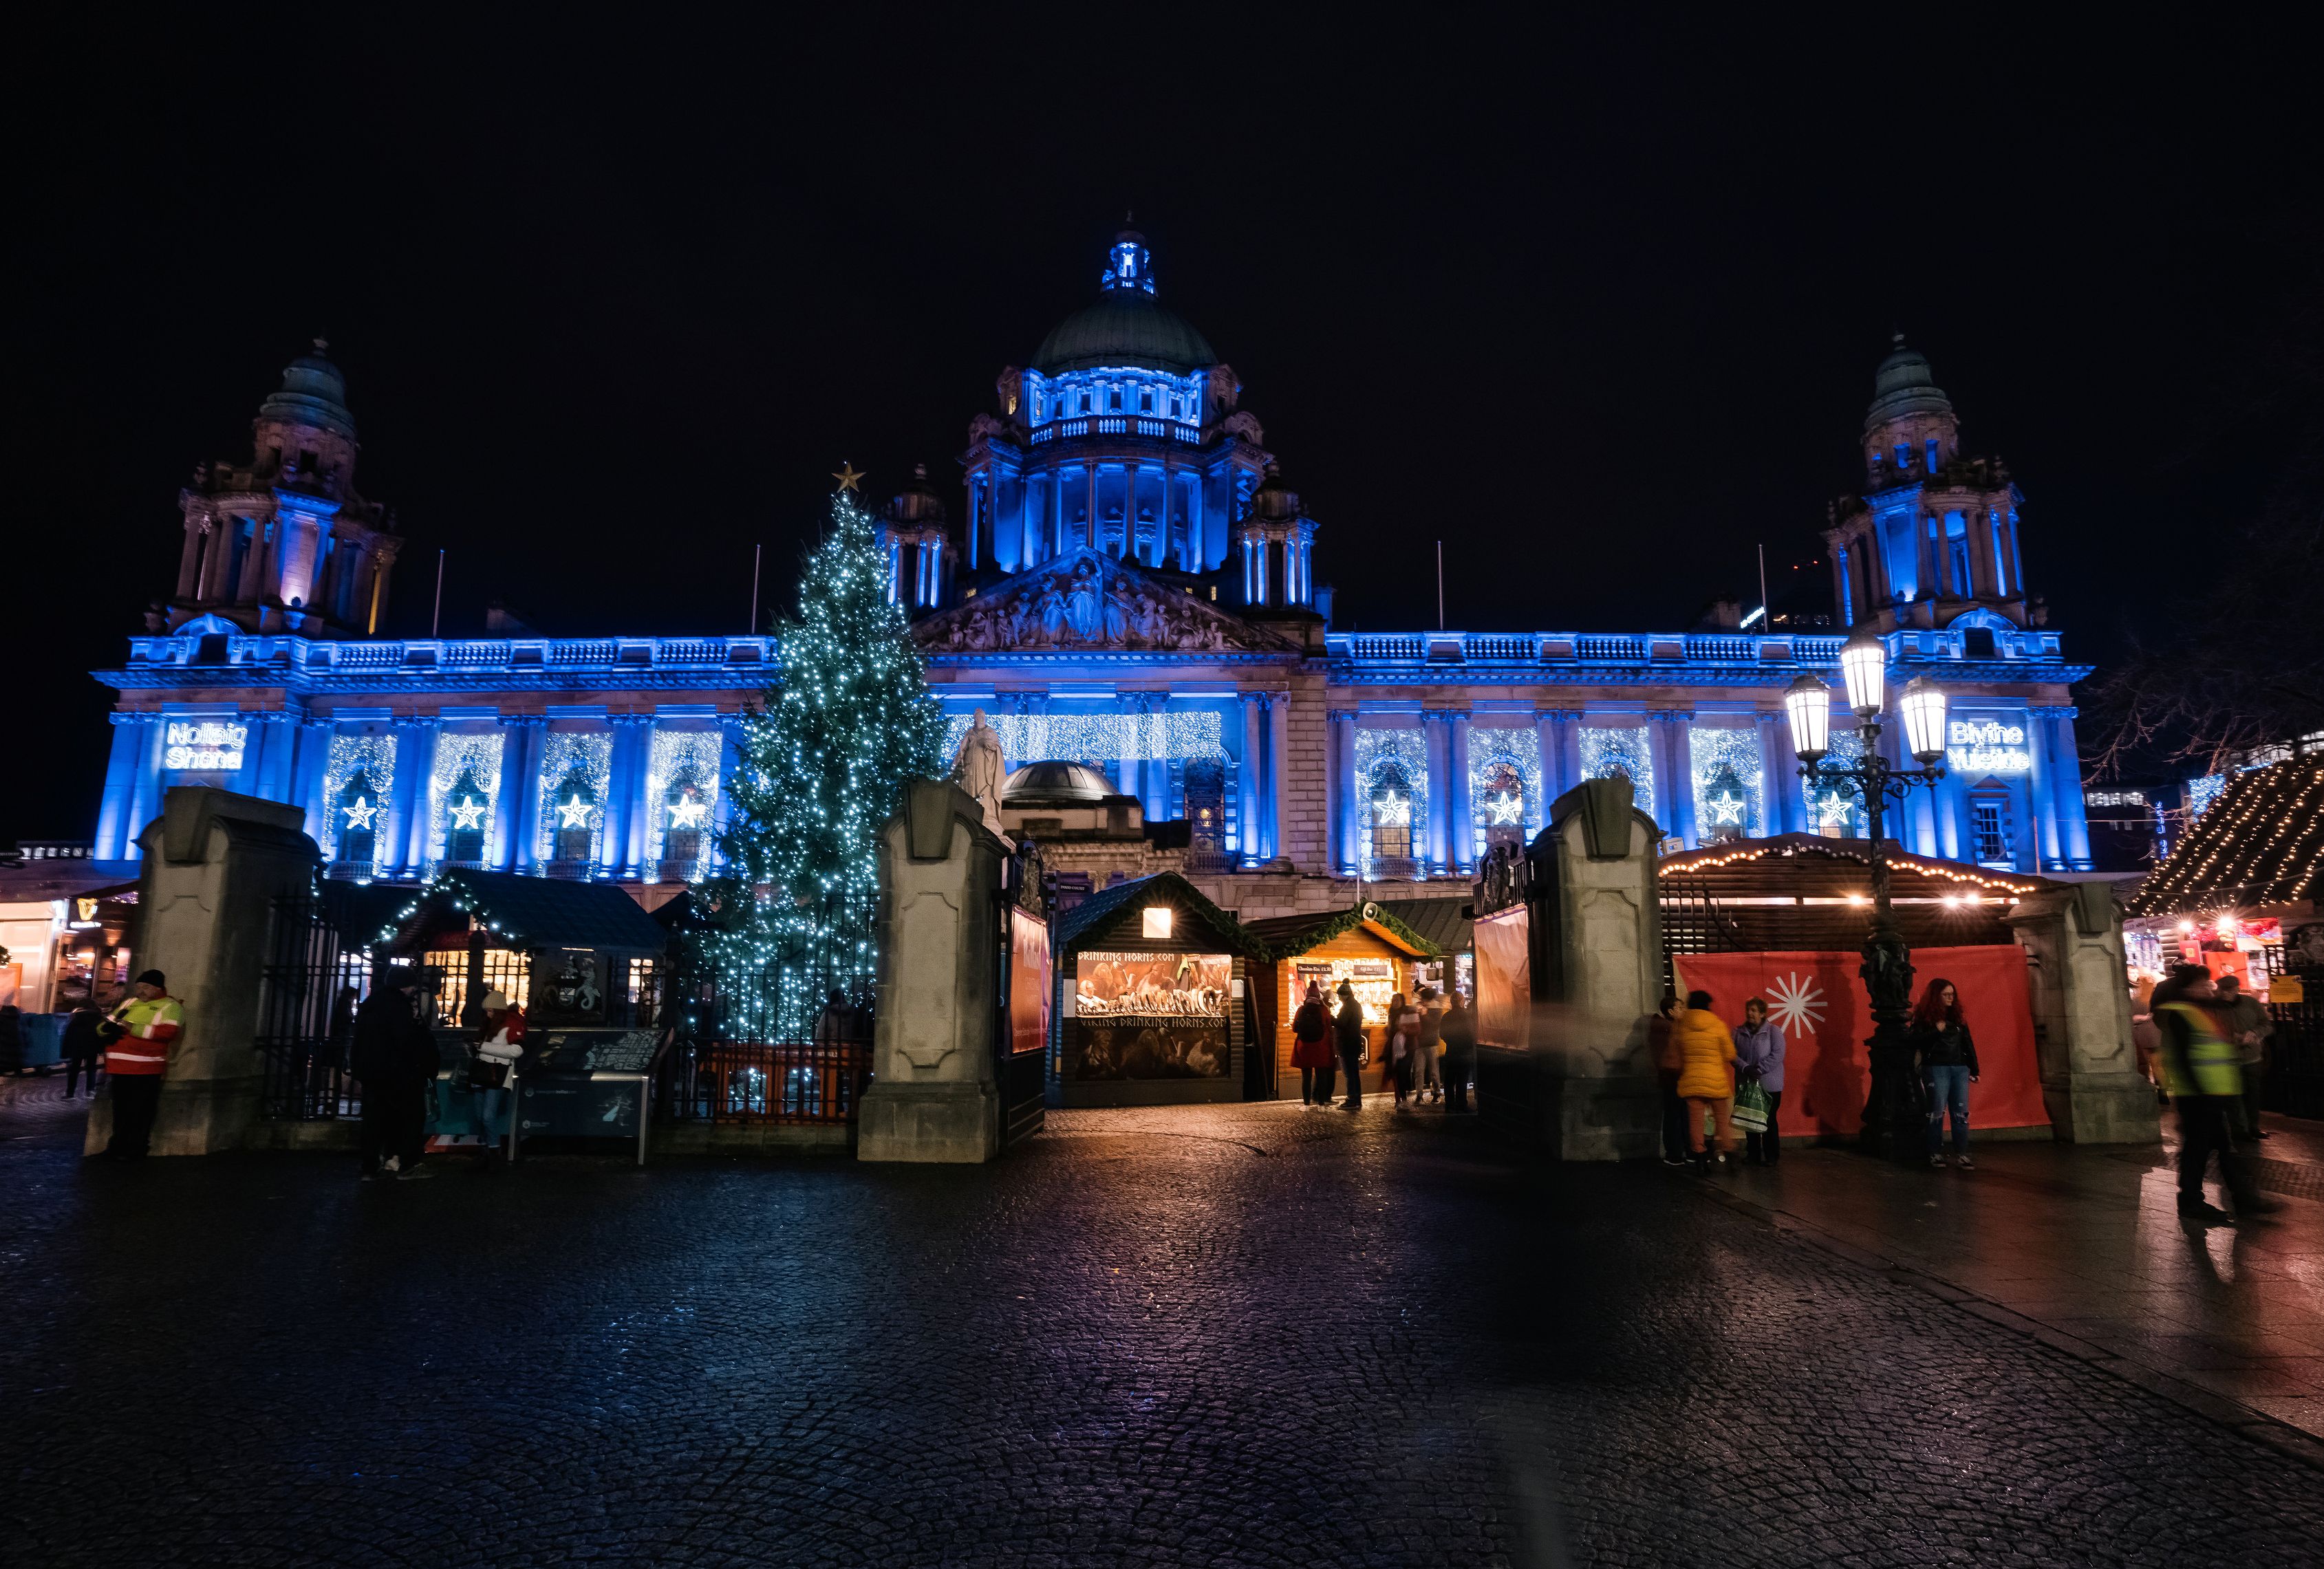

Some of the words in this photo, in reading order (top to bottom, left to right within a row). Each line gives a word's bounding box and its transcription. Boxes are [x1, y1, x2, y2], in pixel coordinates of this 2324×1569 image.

[167, 723, 248, 749] Nollaig
[1951, 722, 2024, 748] Blythe
[165, 747, 242, 769] Shona
[1947, 748, 2030, 770] Yuletide
[1077, 951, 1121, 962] DRINKING
[1081, 1018, 1117, 1027] VIKING
[1120, 1017, 1168, 1027] DRINKING
